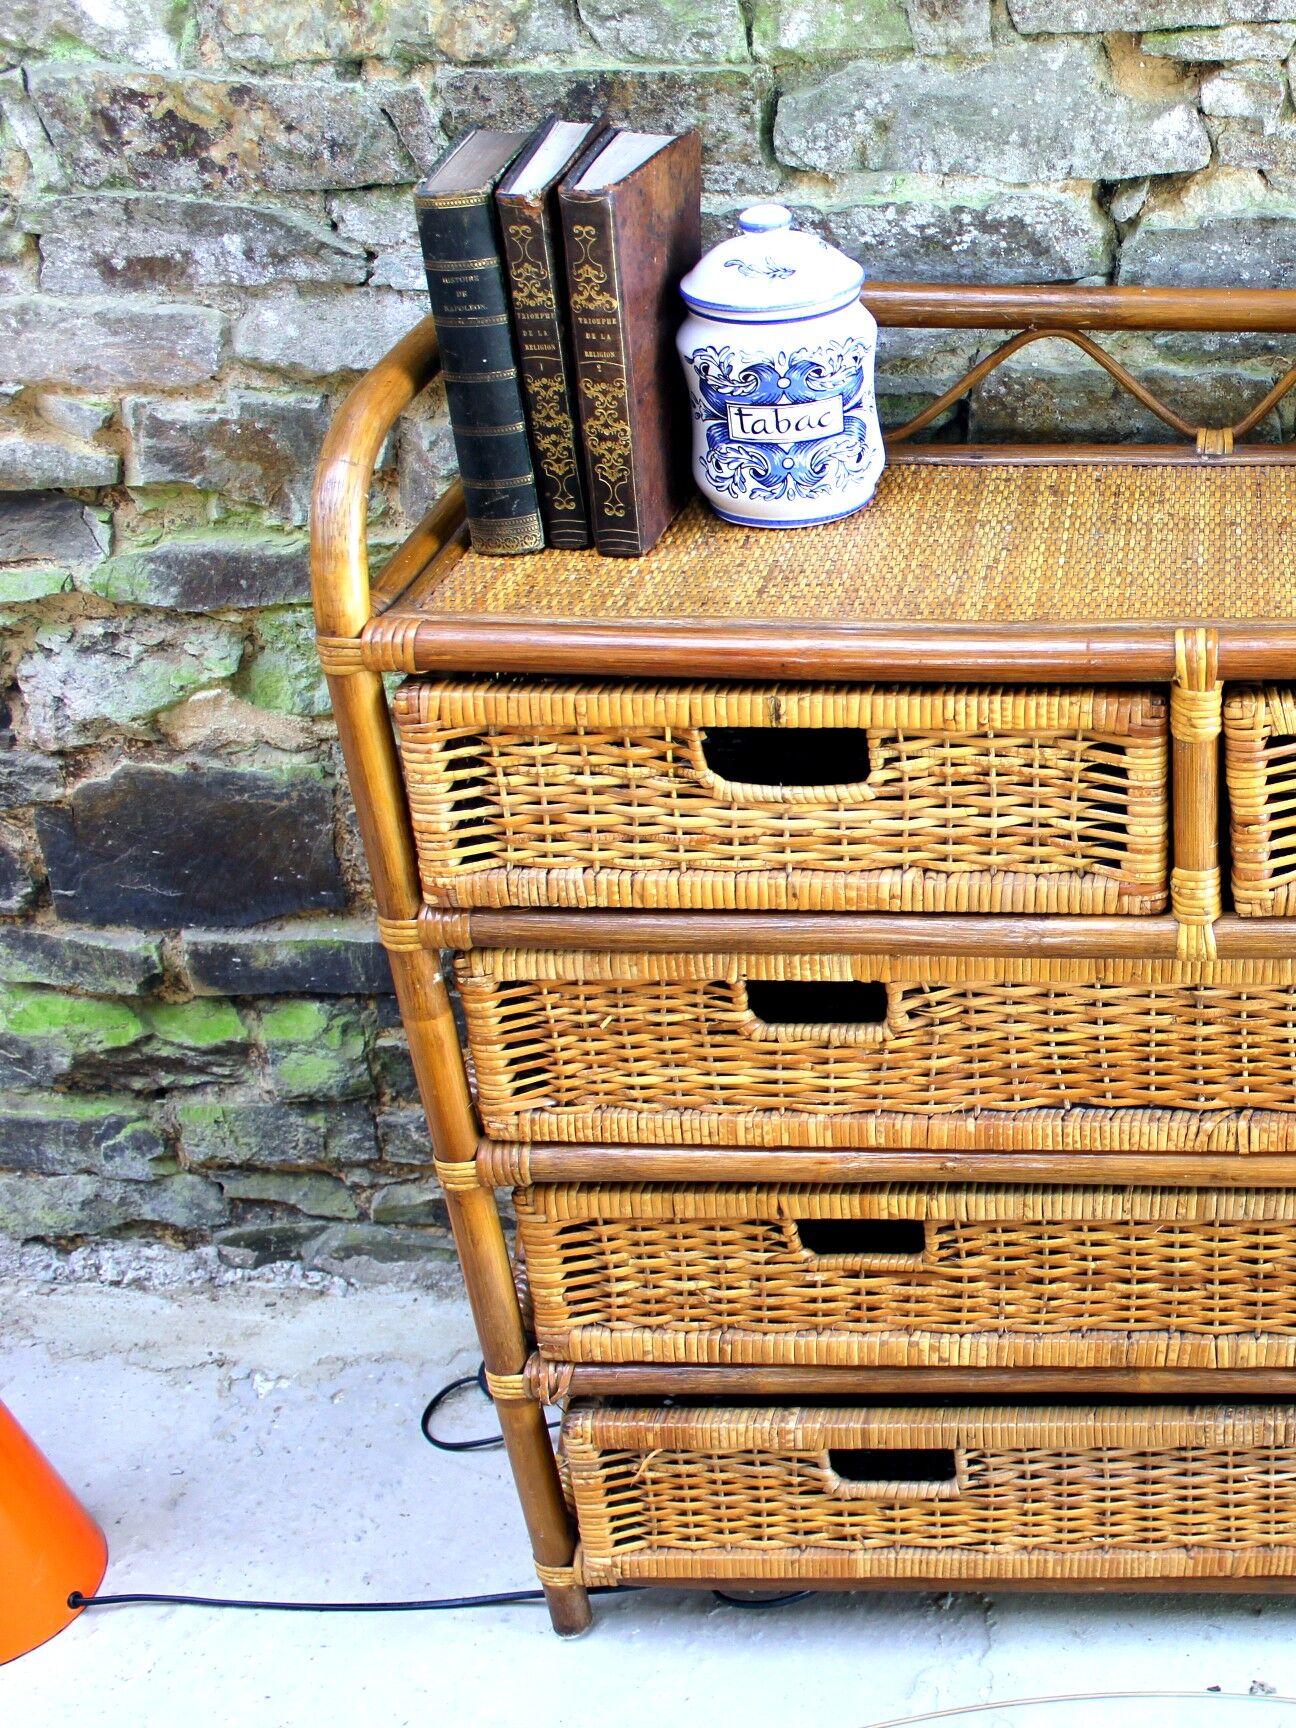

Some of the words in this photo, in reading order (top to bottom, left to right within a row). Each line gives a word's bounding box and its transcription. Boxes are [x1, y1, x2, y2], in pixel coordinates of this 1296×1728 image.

[522, 329, 534, 337] DE
[537, 329, 548, 337] LA
[585, 332, 597, 340] DE
[600, 332, 612, 340] LA
[523, 343, 557, 351] RELIGION
[583, 350, 616, 358] RELIGION
[734, 407, 831, 435] tabac
